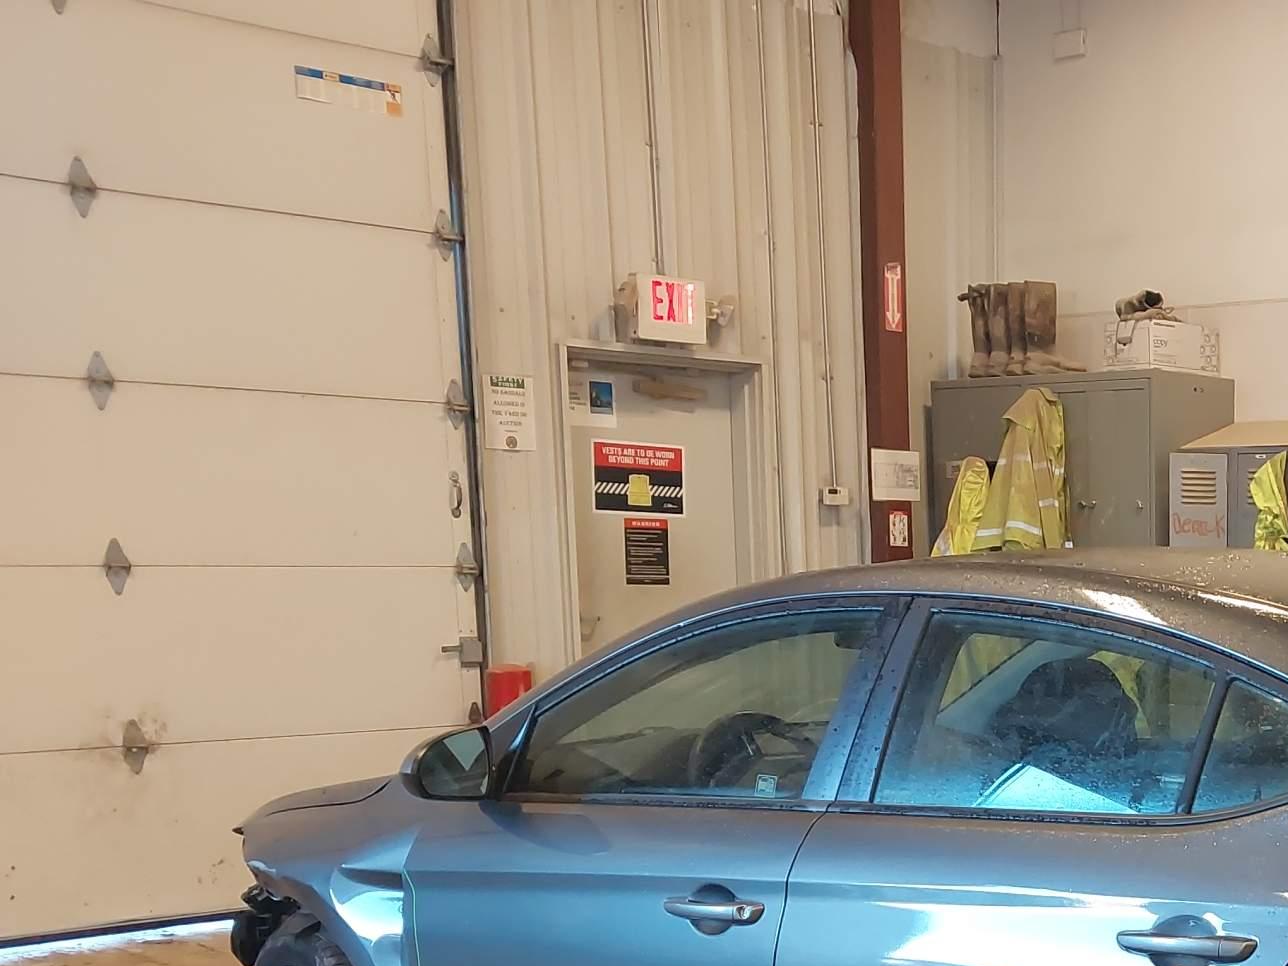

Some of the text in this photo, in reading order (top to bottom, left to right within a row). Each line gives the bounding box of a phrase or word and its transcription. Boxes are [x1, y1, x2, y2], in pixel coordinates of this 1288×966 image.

[652, 280, 694, 325] EXIT
[601, 446, 675, 460] VESTS ARE TO BE WORN
[608, 455, 669, 467] BEYOND THIS POINT
